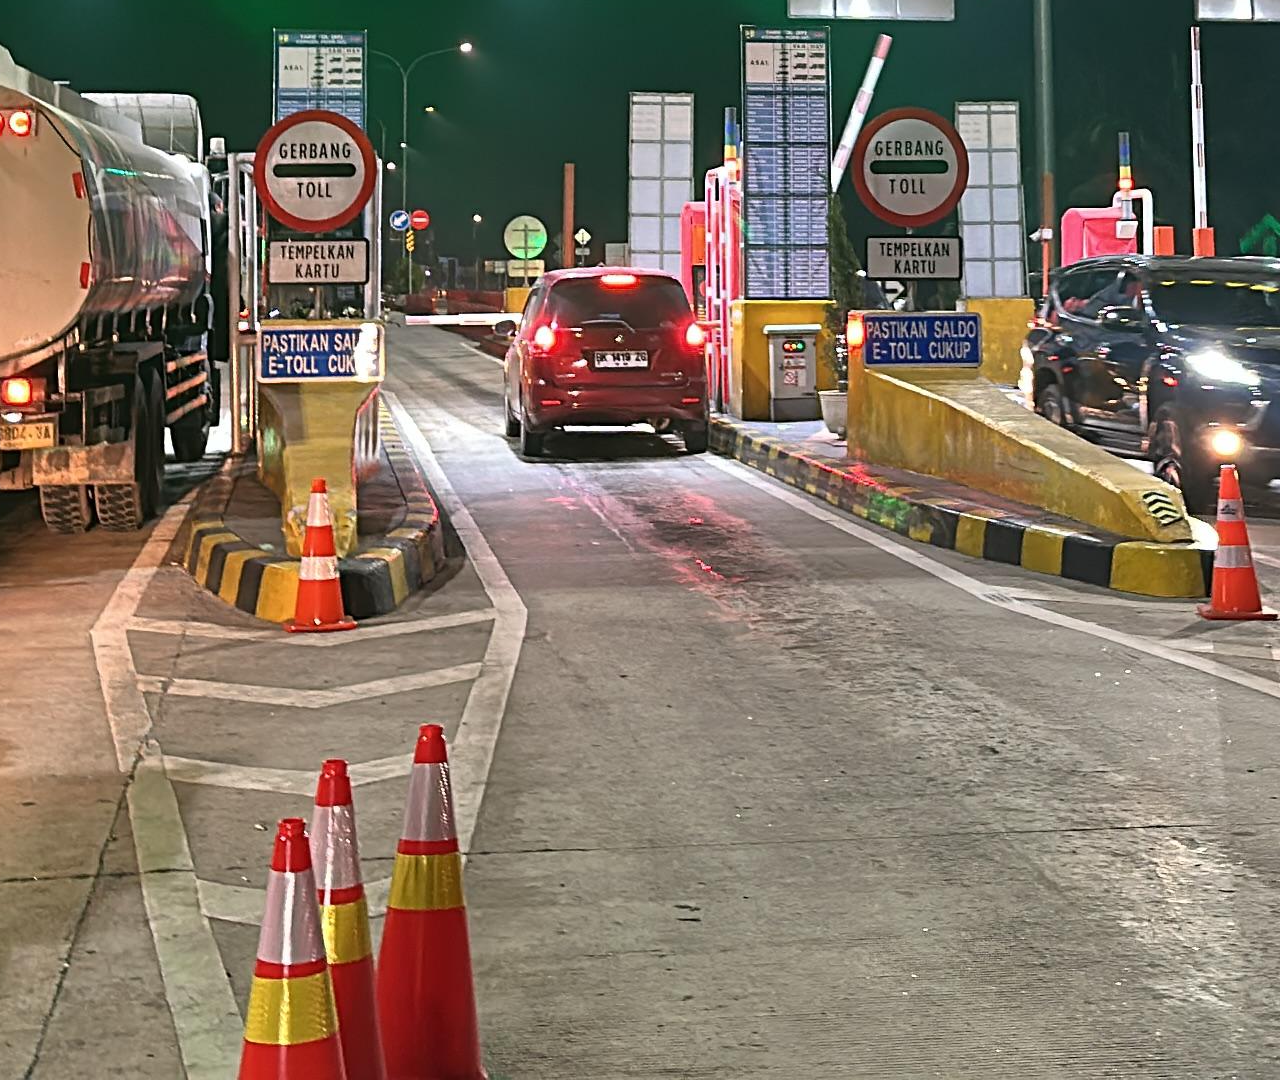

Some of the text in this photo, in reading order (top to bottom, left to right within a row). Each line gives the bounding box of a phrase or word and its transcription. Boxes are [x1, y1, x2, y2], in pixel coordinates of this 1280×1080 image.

[279, 143, 351, 159] GERBANG
[874, 140, 944, 157] GERBANG
[297, 182, 333, 198] TOLL
[889, 179, 926, 195] TOLL
[281, 245, 354, 260] TEMPELKAN
[879, 242, 950, 258] TEMPELKAN
[295, 263, 340, 279] KARTU
[894, 260, 936, 275] KARTU
[866, 320, 977, 339] PASTIKAN SALDO
[263, 333, 329, 353] PASTIKAN
[872, 341, 971, 360] E-TOLL CUKUP
[268, 355, 319, 374] E-TOLL
